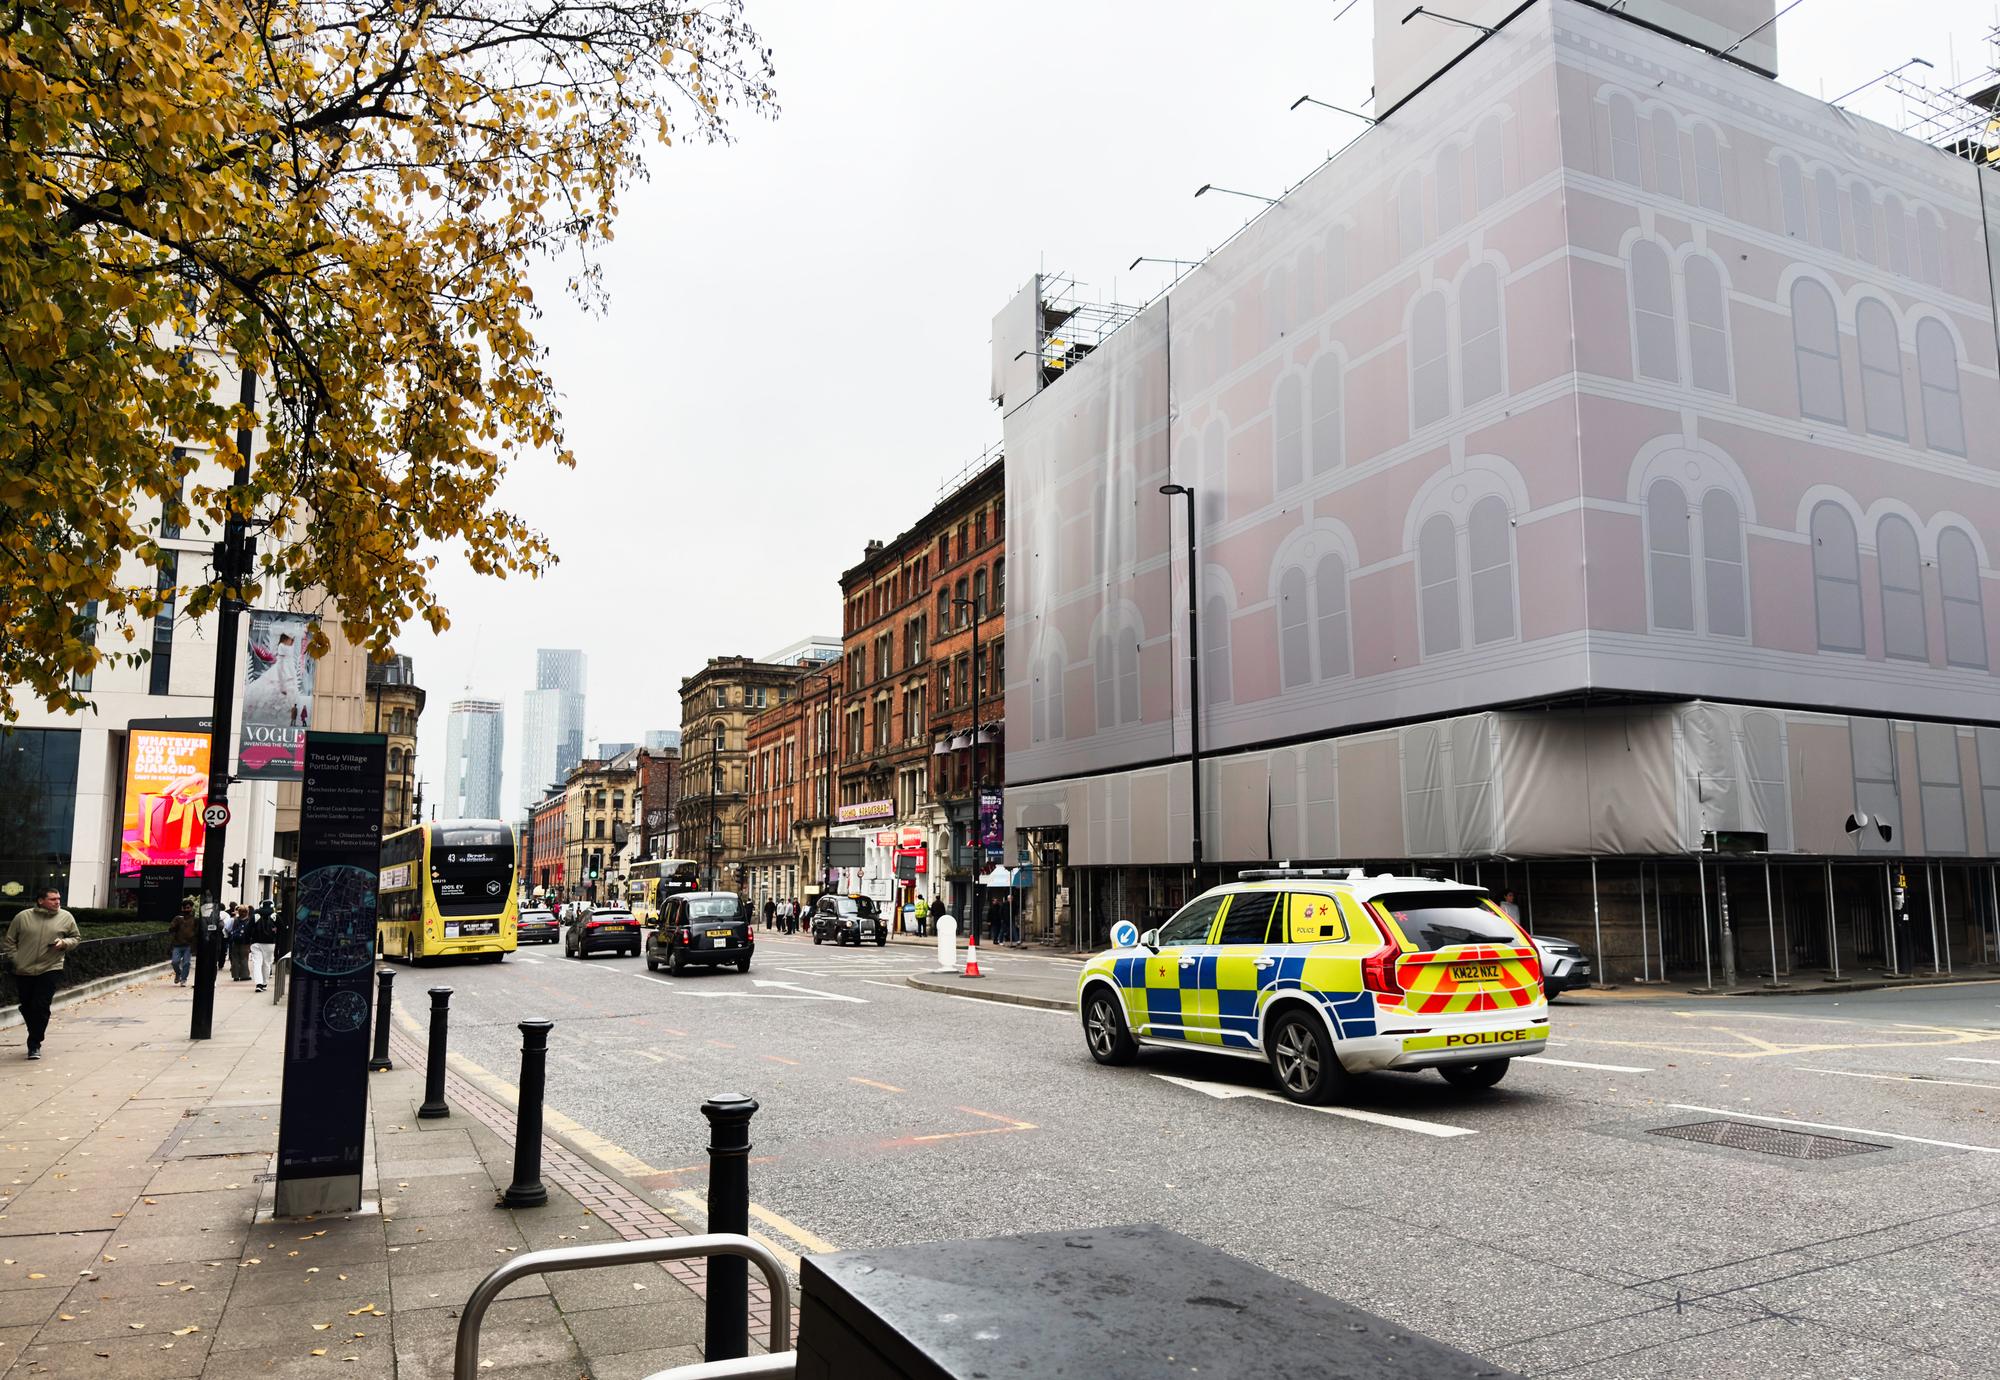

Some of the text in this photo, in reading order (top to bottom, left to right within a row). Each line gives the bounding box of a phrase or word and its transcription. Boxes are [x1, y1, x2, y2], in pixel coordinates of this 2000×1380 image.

[246, 726, 305, 743] VOGUE
[138, 736, 208, 748] WHATEVER
[137, 745, 195, 757] YOU GIFT
[136, 753, 177, 764] ADD A
[311, 753, 368, 764] The Gay Village
[135, 763, 196, 774] DIAMOND
[309, 762, 339, 771] Portland
[340, 763, 361, 771] Street
[207, 809, 227, 821] 20
[447, 853, 456, 863] 43
[1480, 965, 1499, 978] NXZ
[1446, 1029, 1527, 1046] POLICE
